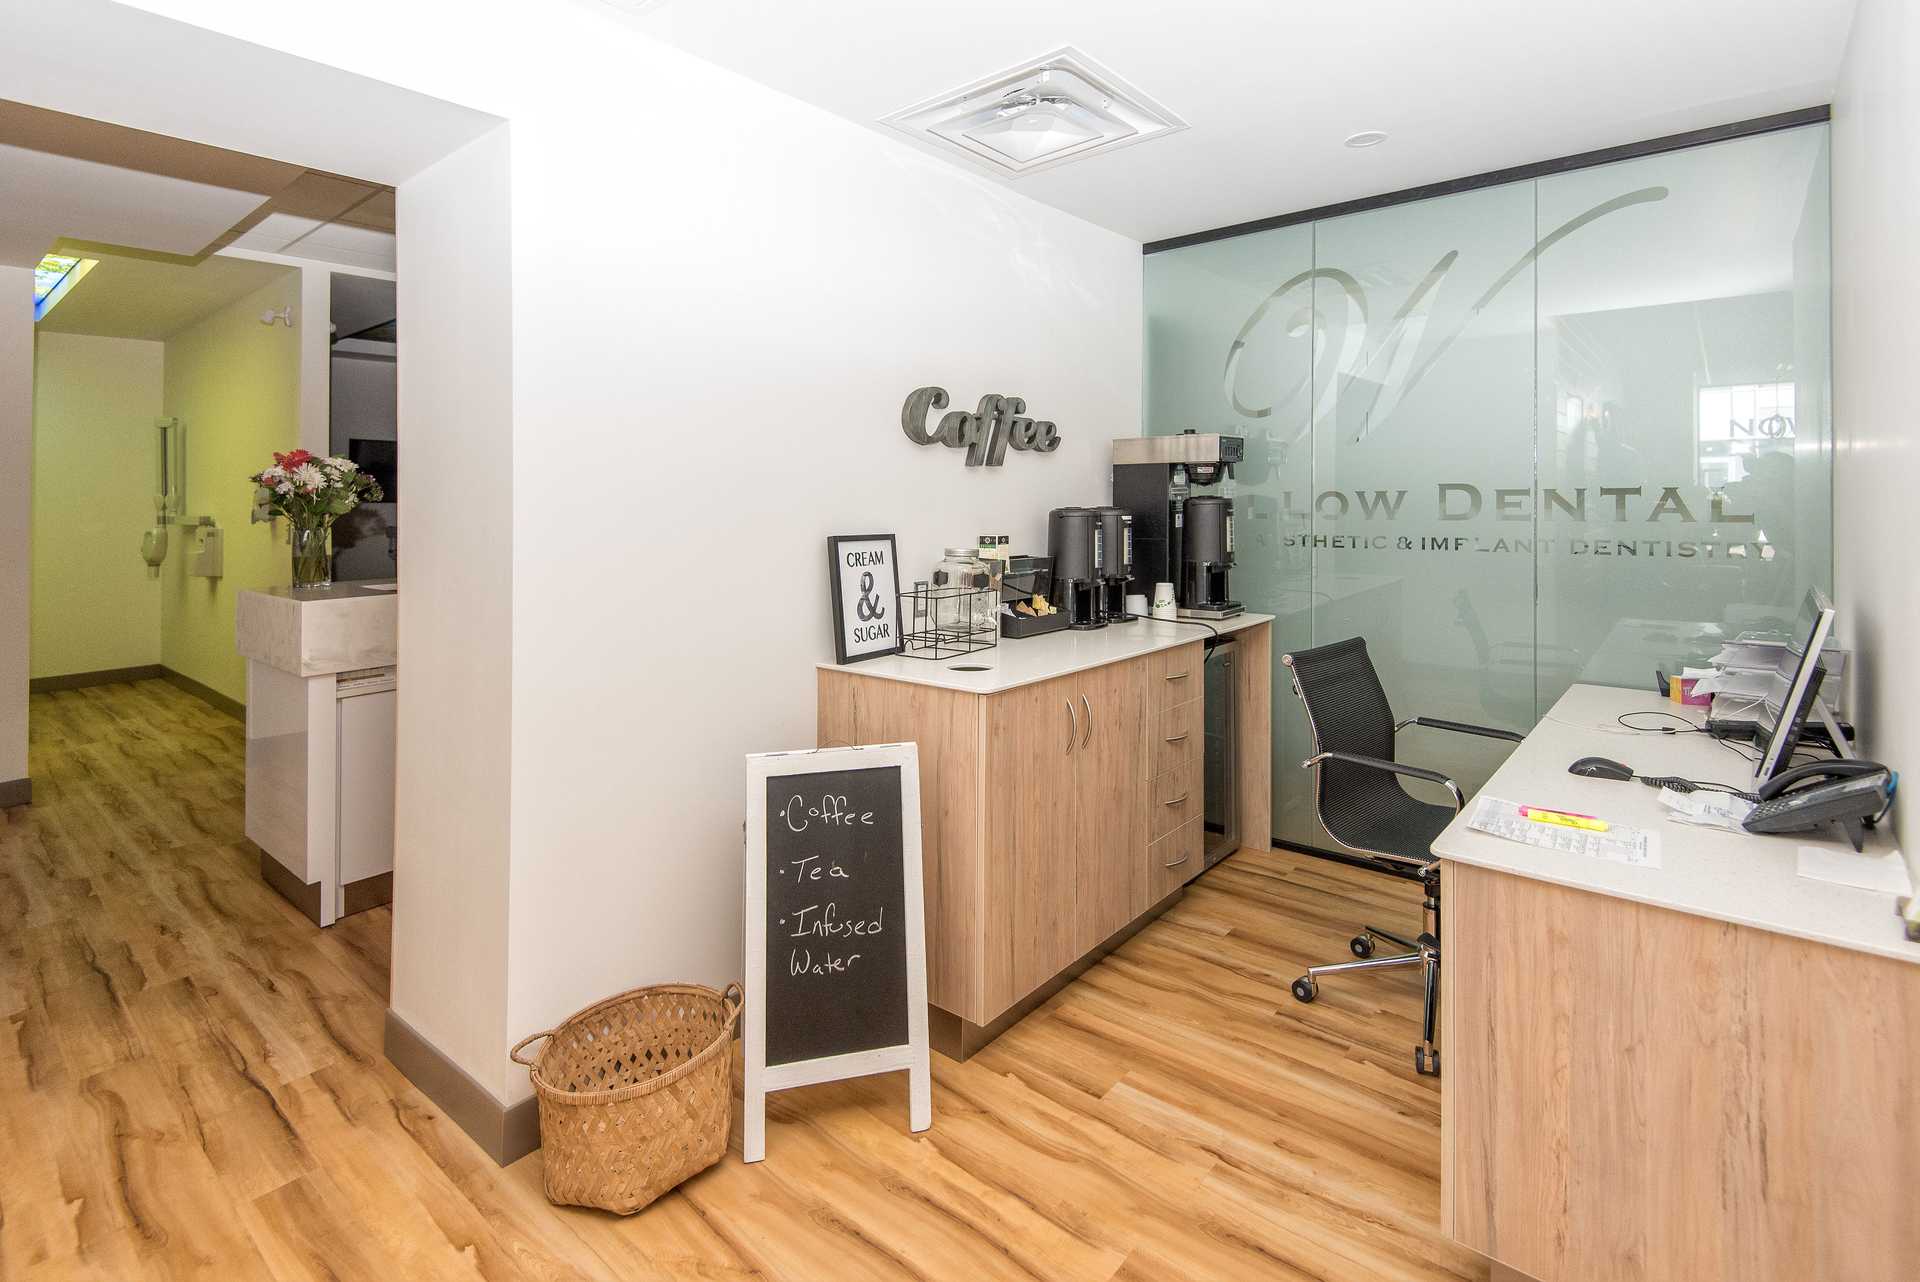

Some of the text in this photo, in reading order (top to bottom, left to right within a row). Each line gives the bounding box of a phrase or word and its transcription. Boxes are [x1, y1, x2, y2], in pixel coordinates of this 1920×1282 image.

[901, 386, 1062, 467] Coffee
[1437, 482, 1755, 525] DENTAL
[846, 550, 885, 568] CREAM
[856, 571, 886, 622] &
[853, 623, 890, 644] SUGAR
[786, 794, 875, 832] Coffee
[791, 855, 850, 885] Tea
[790, 902, 884, 939] Infused
[789, 948, 862, 977] Water
